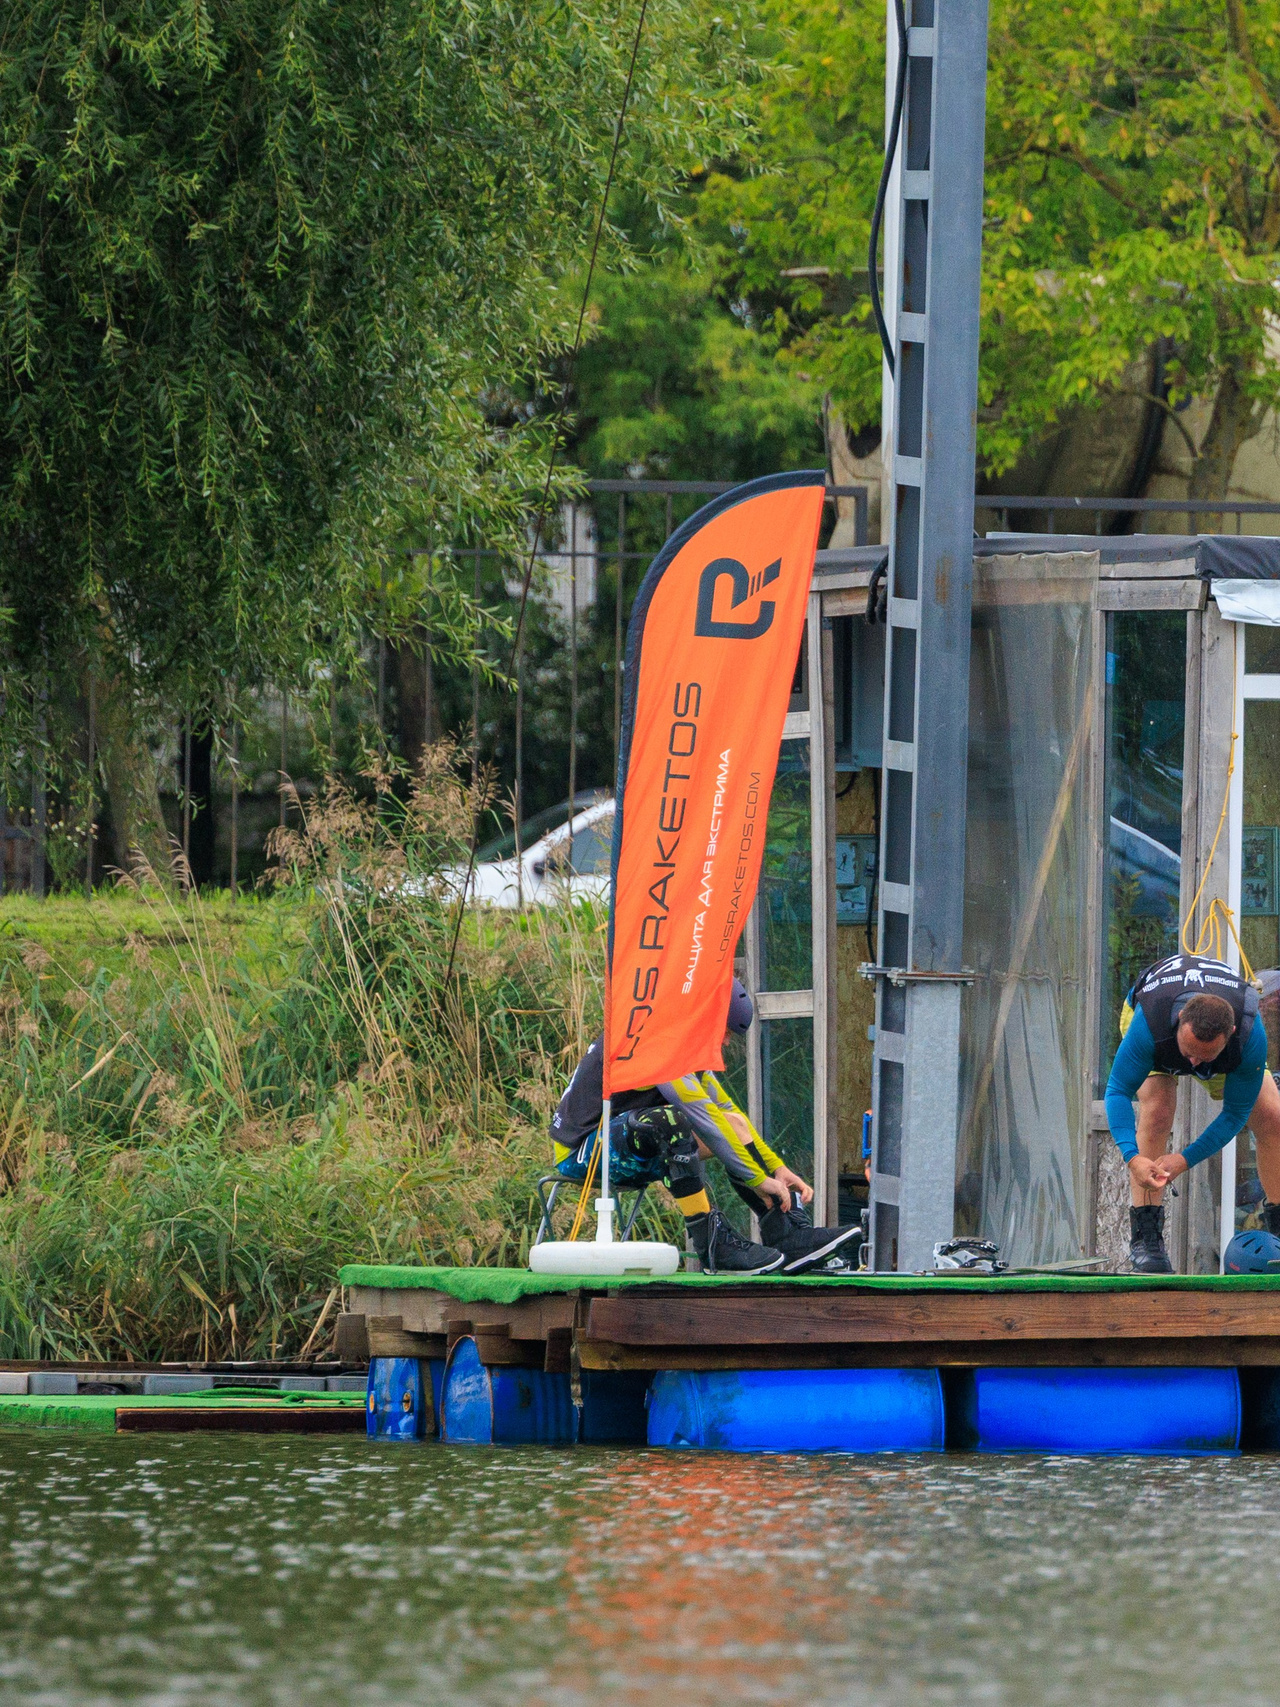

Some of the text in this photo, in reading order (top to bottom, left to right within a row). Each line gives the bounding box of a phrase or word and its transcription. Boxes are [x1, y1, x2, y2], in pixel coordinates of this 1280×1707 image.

[614, 681, 702, 1061] LOS RAKETOS
[681, 748, 731, 995] ЗАЩИТА ДЛЯ ЭКСТРИМА
[716, 771, 761, 963] LOSRAKETOS.COM
